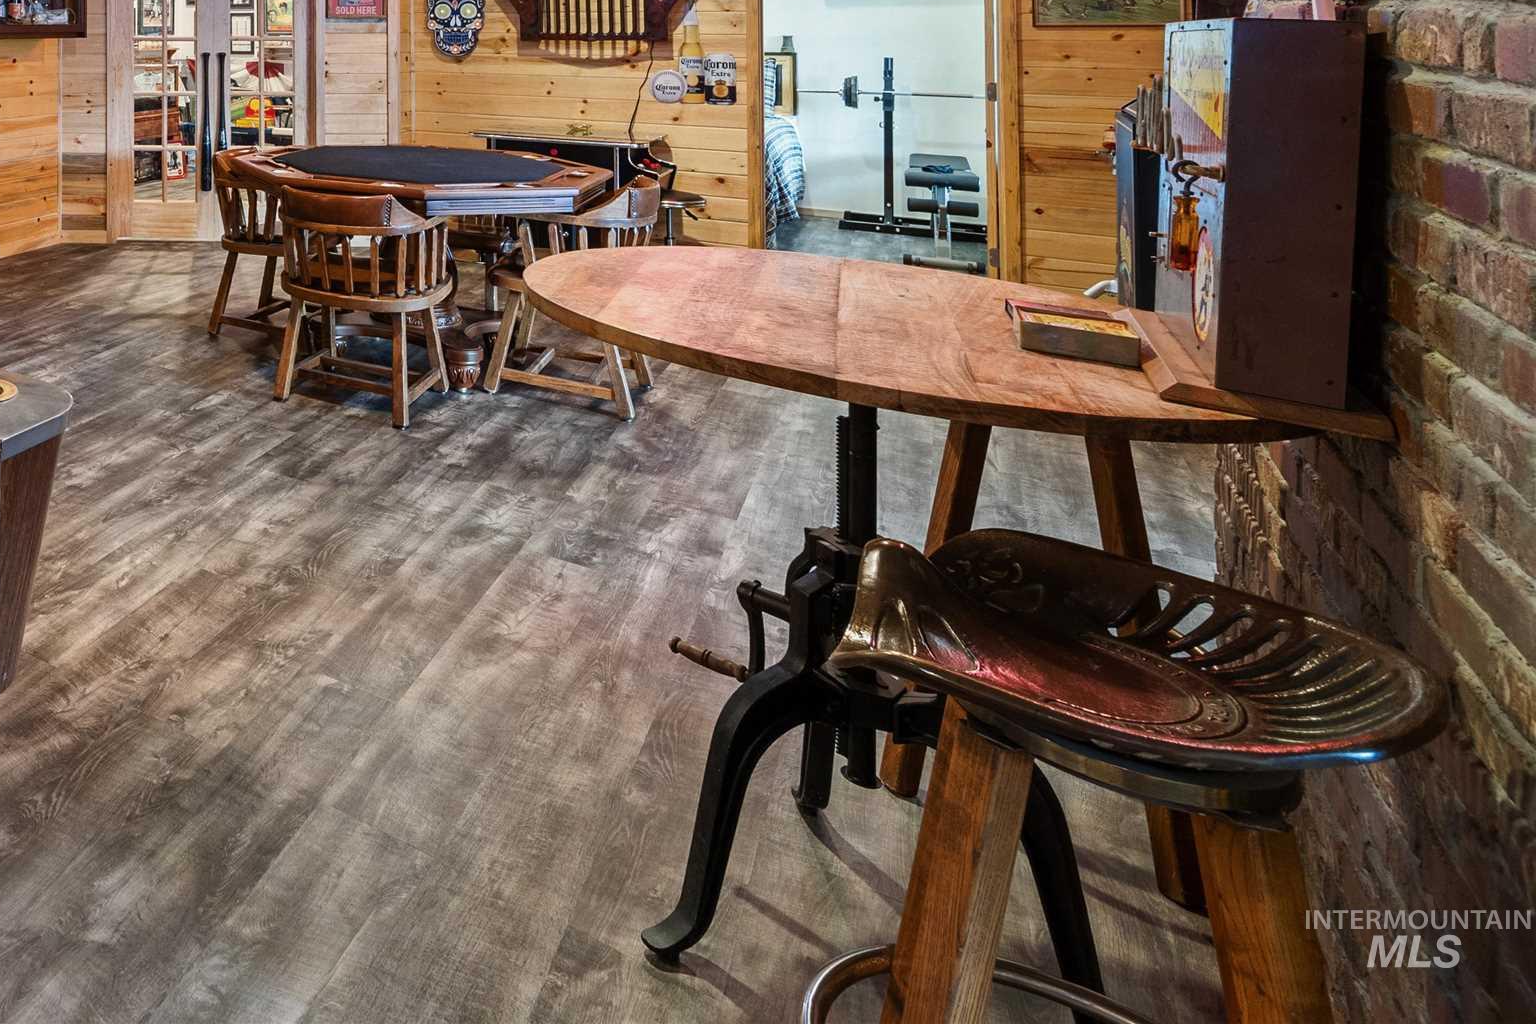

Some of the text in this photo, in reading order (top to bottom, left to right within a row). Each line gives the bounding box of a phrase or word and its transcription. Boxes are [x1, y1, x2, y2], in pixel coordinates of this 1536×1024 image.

[335, 6, 377, 15] SOLD HERE
[655, 83, 681, 91] Corona
